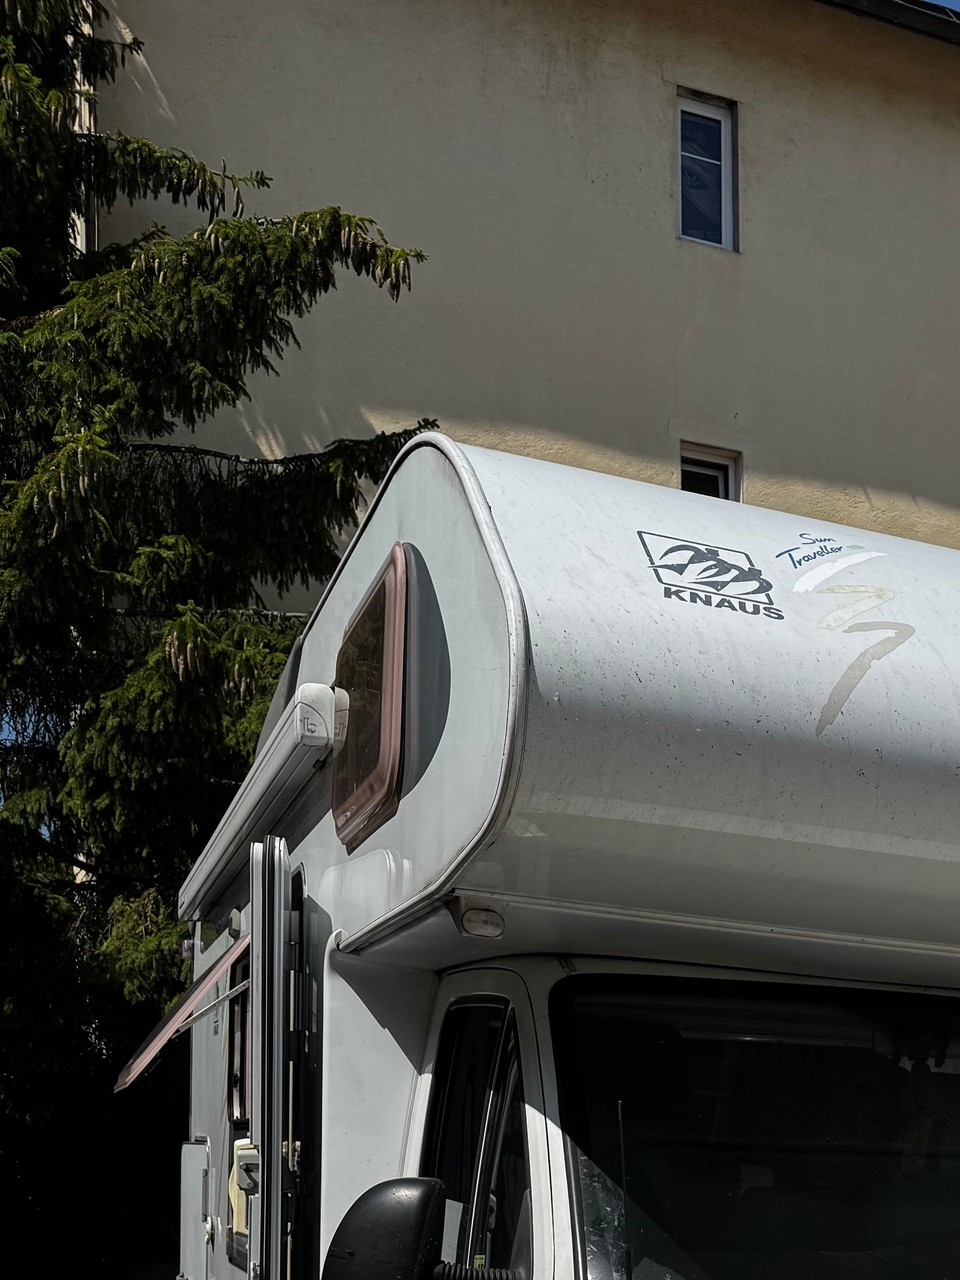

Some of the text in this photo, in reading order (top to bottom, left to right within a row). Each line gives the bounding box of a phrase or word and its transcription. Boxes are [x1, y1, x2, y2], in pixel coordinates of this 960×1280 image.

[799, 533, 836, 545] Sun
[775, 545, 843, 569] Traveller
[664, 587, 785, 620] KNAUS
